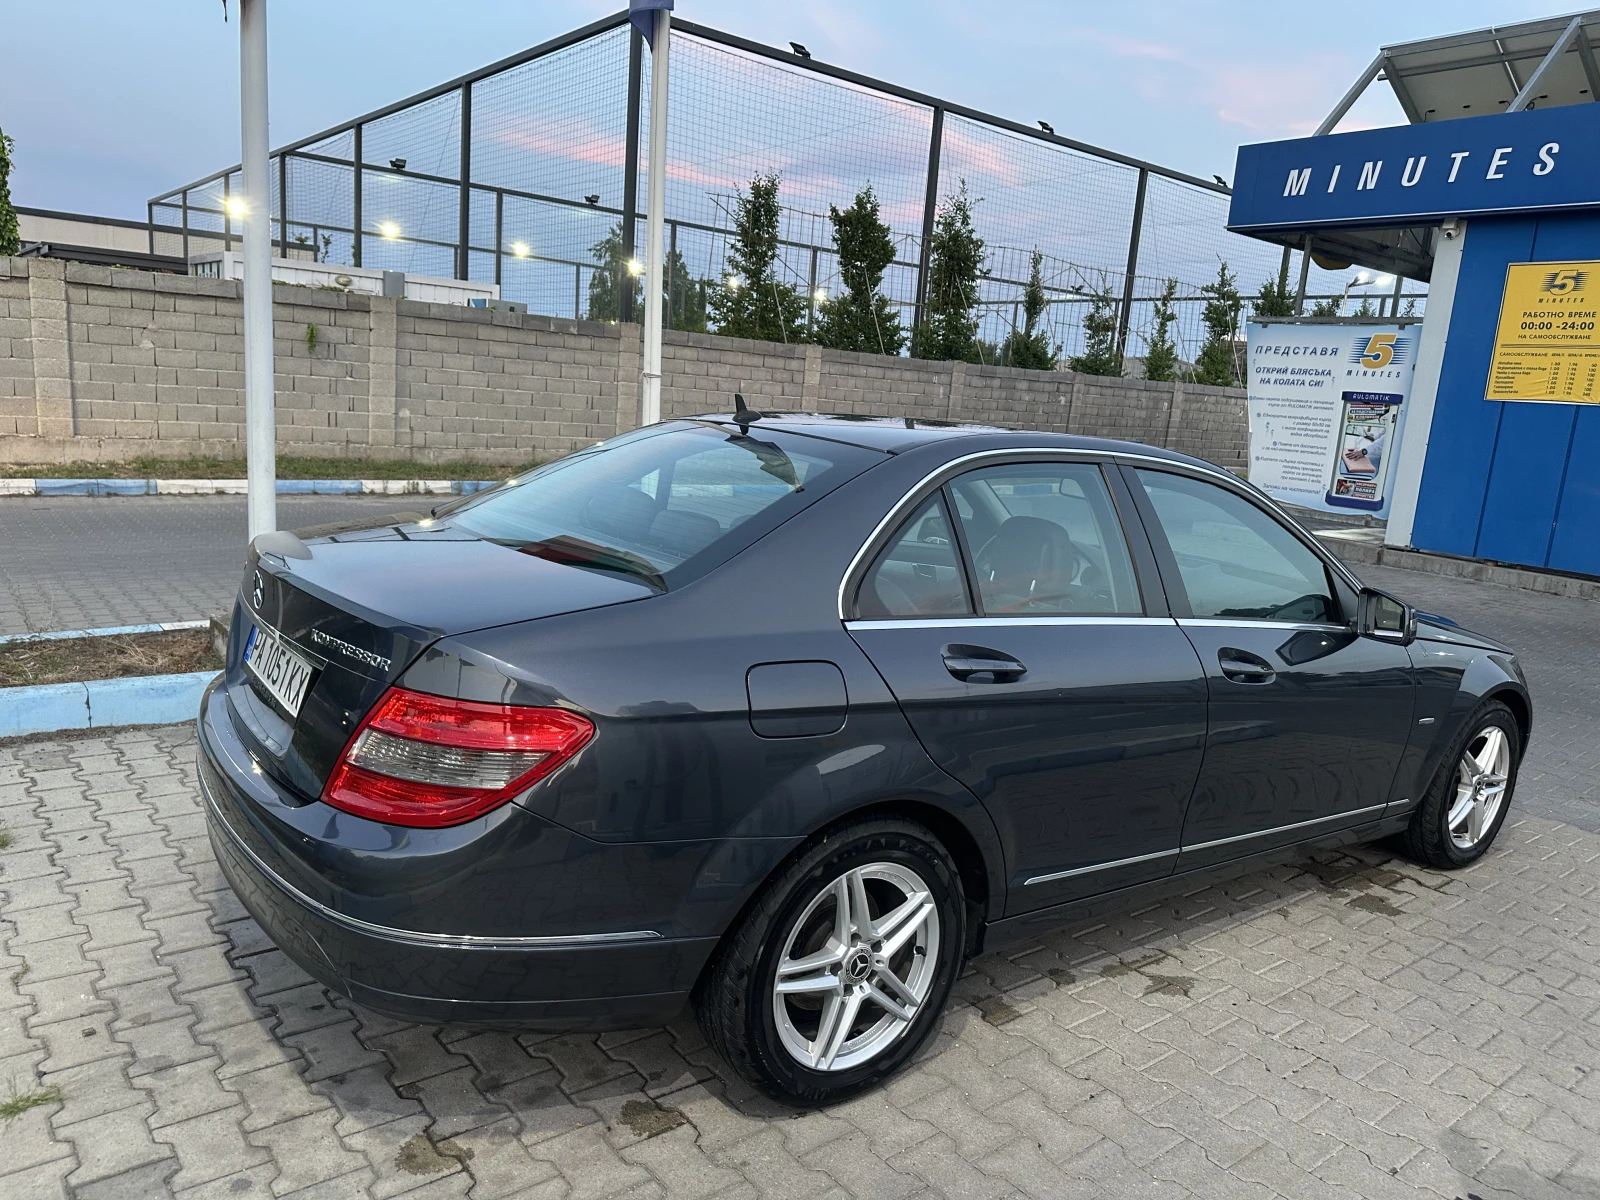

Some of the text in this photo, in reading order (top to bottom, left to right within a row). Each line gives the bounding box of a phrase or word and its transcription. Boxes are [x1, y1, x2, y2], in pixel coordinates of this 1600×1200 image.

[1283, 142, 1560, 196] MINUTES
[1550, 270, 1578, 295] 5
[1255, 345, 1339, 356] ПРЕДСТАВЯ
[1360, 333, 1397, 369] 5
[1255, 366, 1331, 376] ОТКРИЙ БЛЯСЪКА
[1346, 370, 1401, 378] MINUTES
[1273, 378, 1305, 386] КОЛАТА
[1308, 379, 1324, 387] СИ!
[311, 628, 391, 672] KOMPRESSOR
